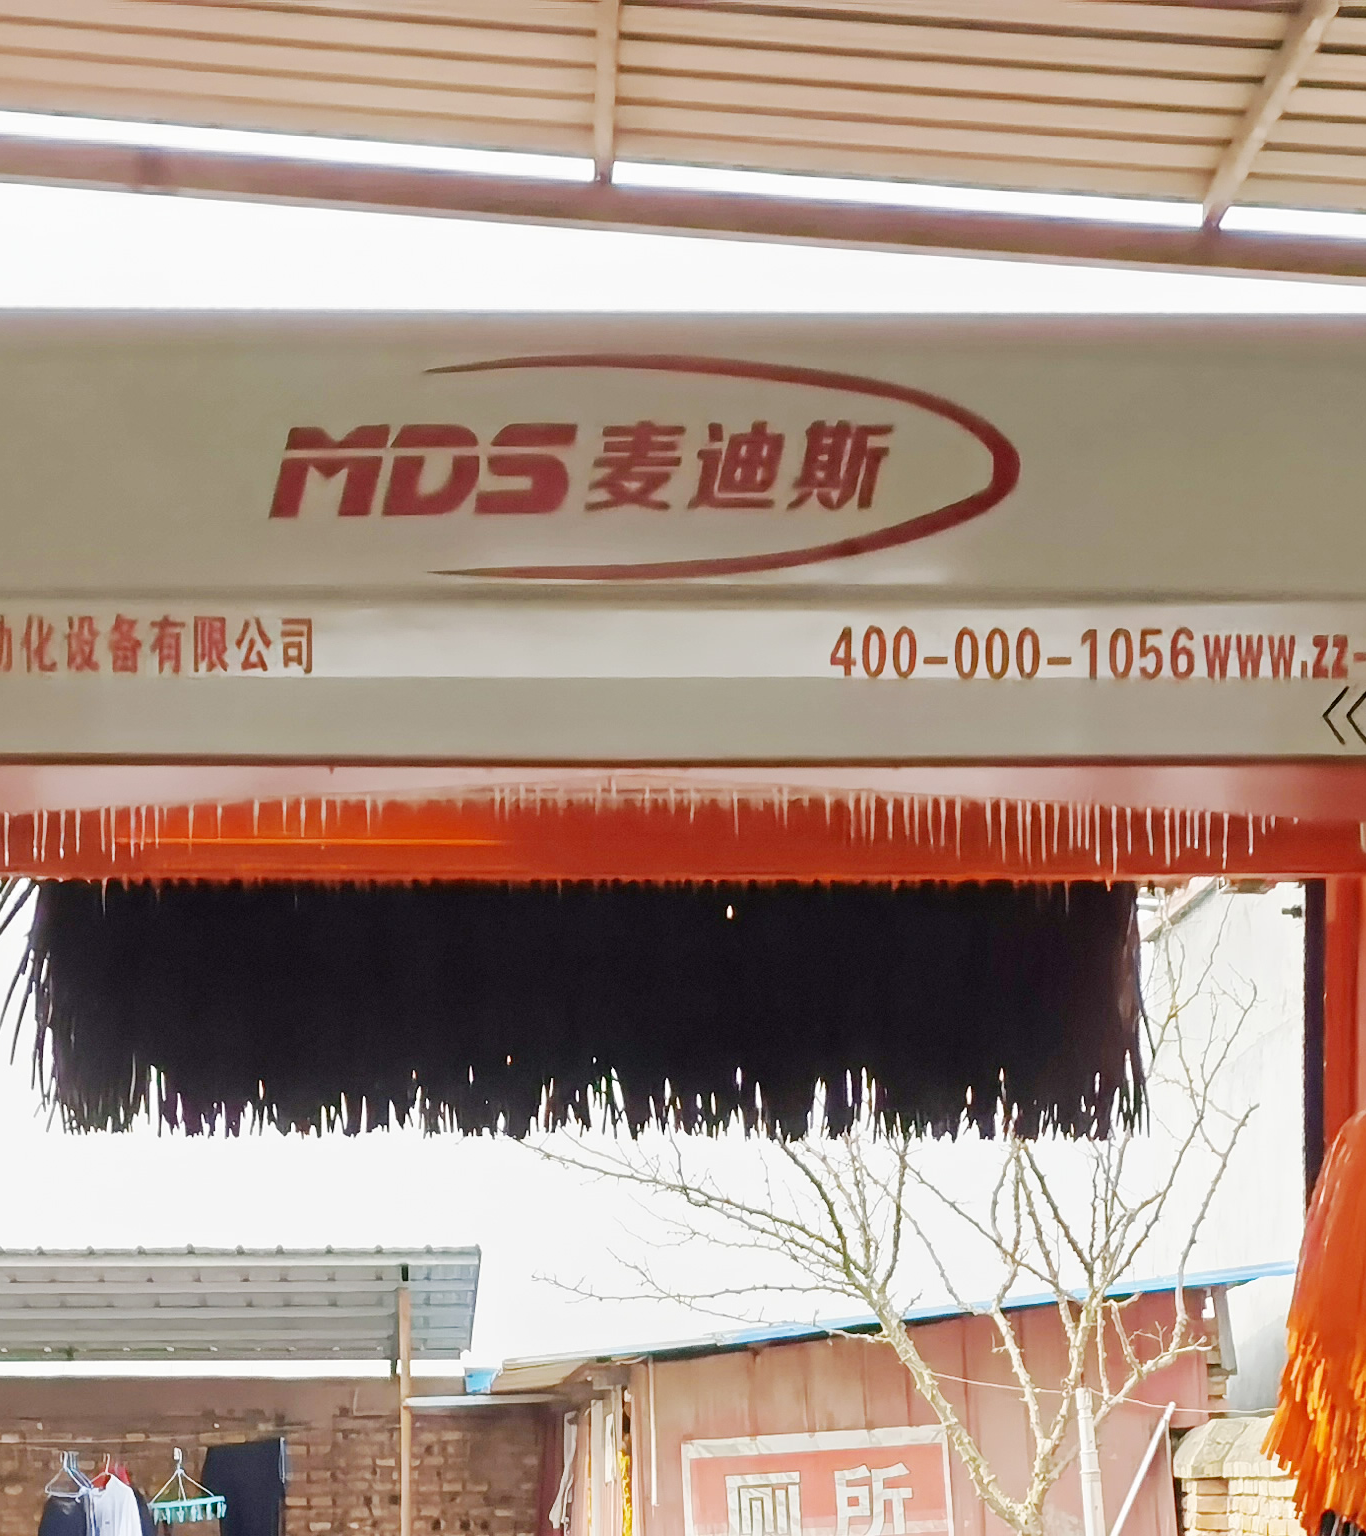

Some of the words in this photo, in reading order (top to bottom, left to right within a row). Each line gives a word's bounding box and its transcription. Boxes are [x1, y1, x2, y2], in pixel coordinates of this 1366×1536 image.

[268, 423, 579, 520] MDS
[584, 419, 895, 512] 麦迪斯
